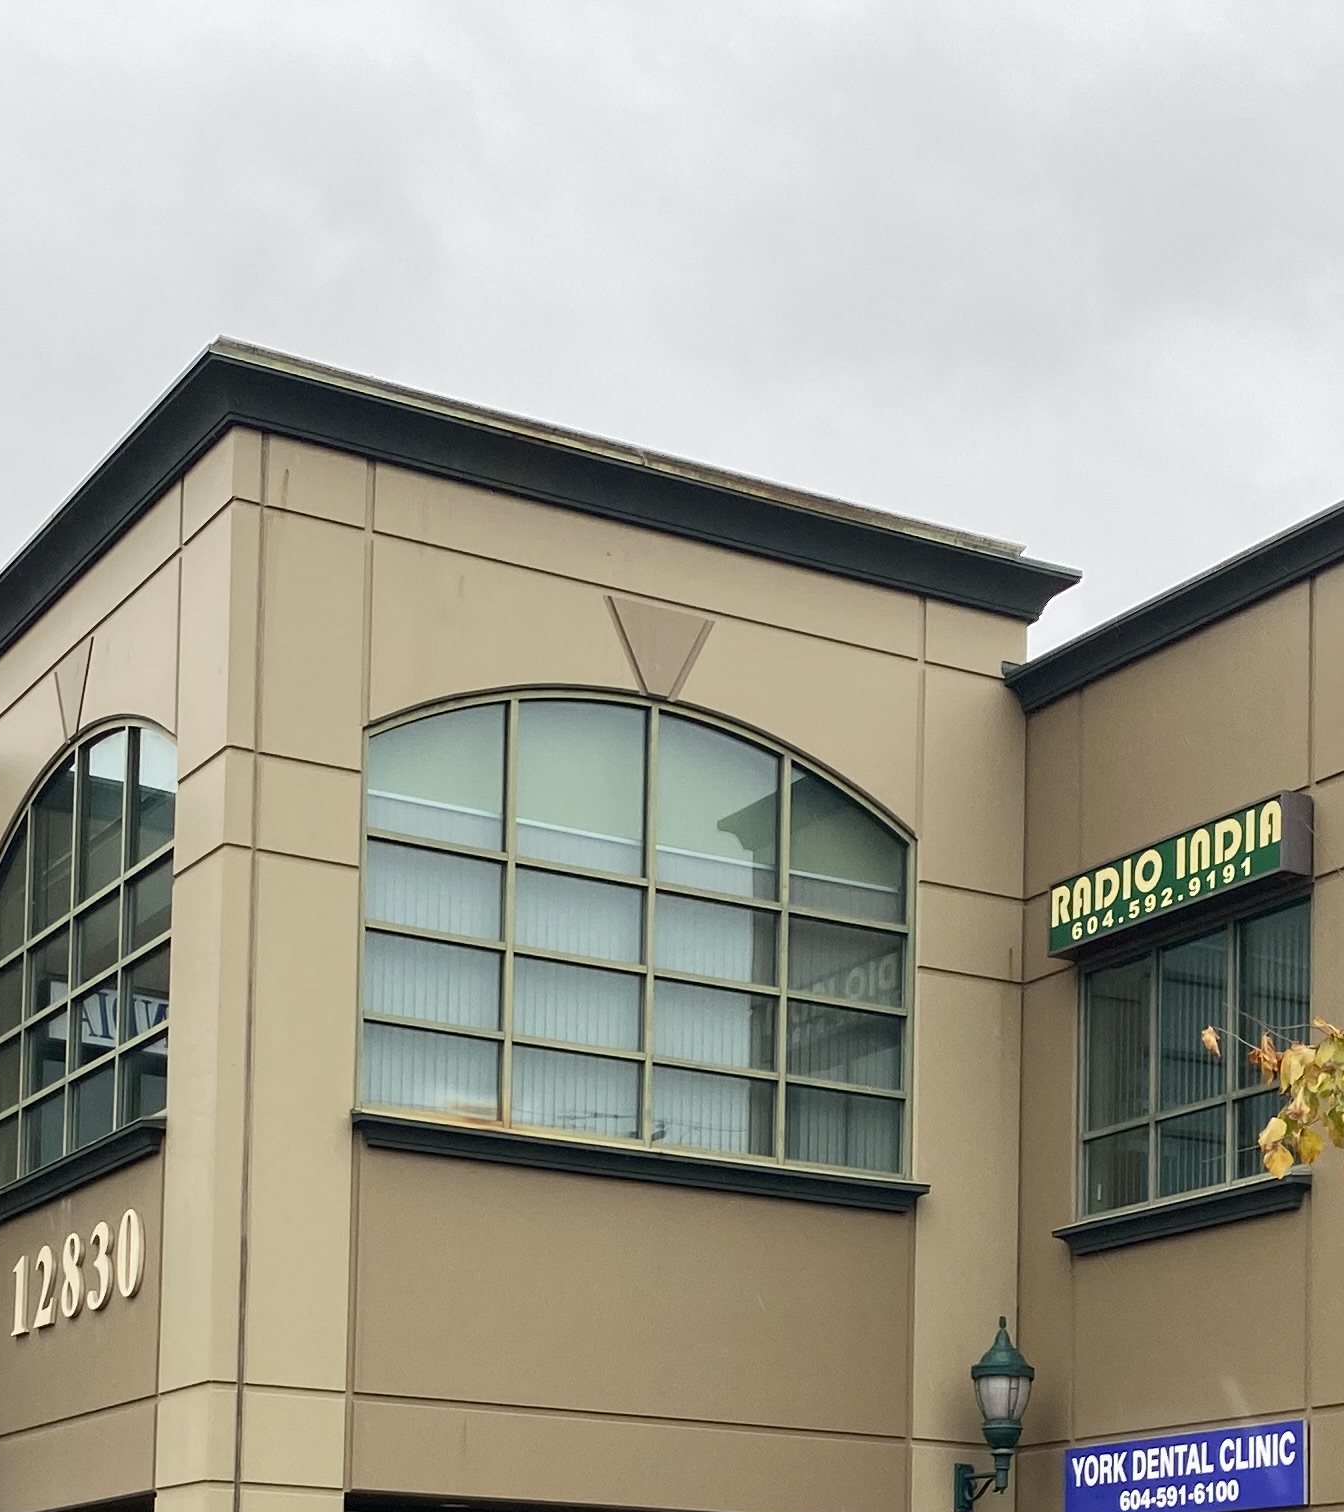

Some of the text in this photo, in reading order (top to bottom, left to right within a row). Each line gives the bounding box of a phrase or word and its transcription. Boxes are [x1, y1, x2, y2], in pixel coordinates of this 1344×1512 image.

[1051, 800, 1283, 928] RADIO INDIA
[1071, 855, 1253, 941] 604.592.9191
[10, 1208, 144, 1338] 12830
[1071, 1430, 1296, 1488] YORK DENTAL CLINIC
[1119, 1479, 1240, 1512] 604-591-6100
